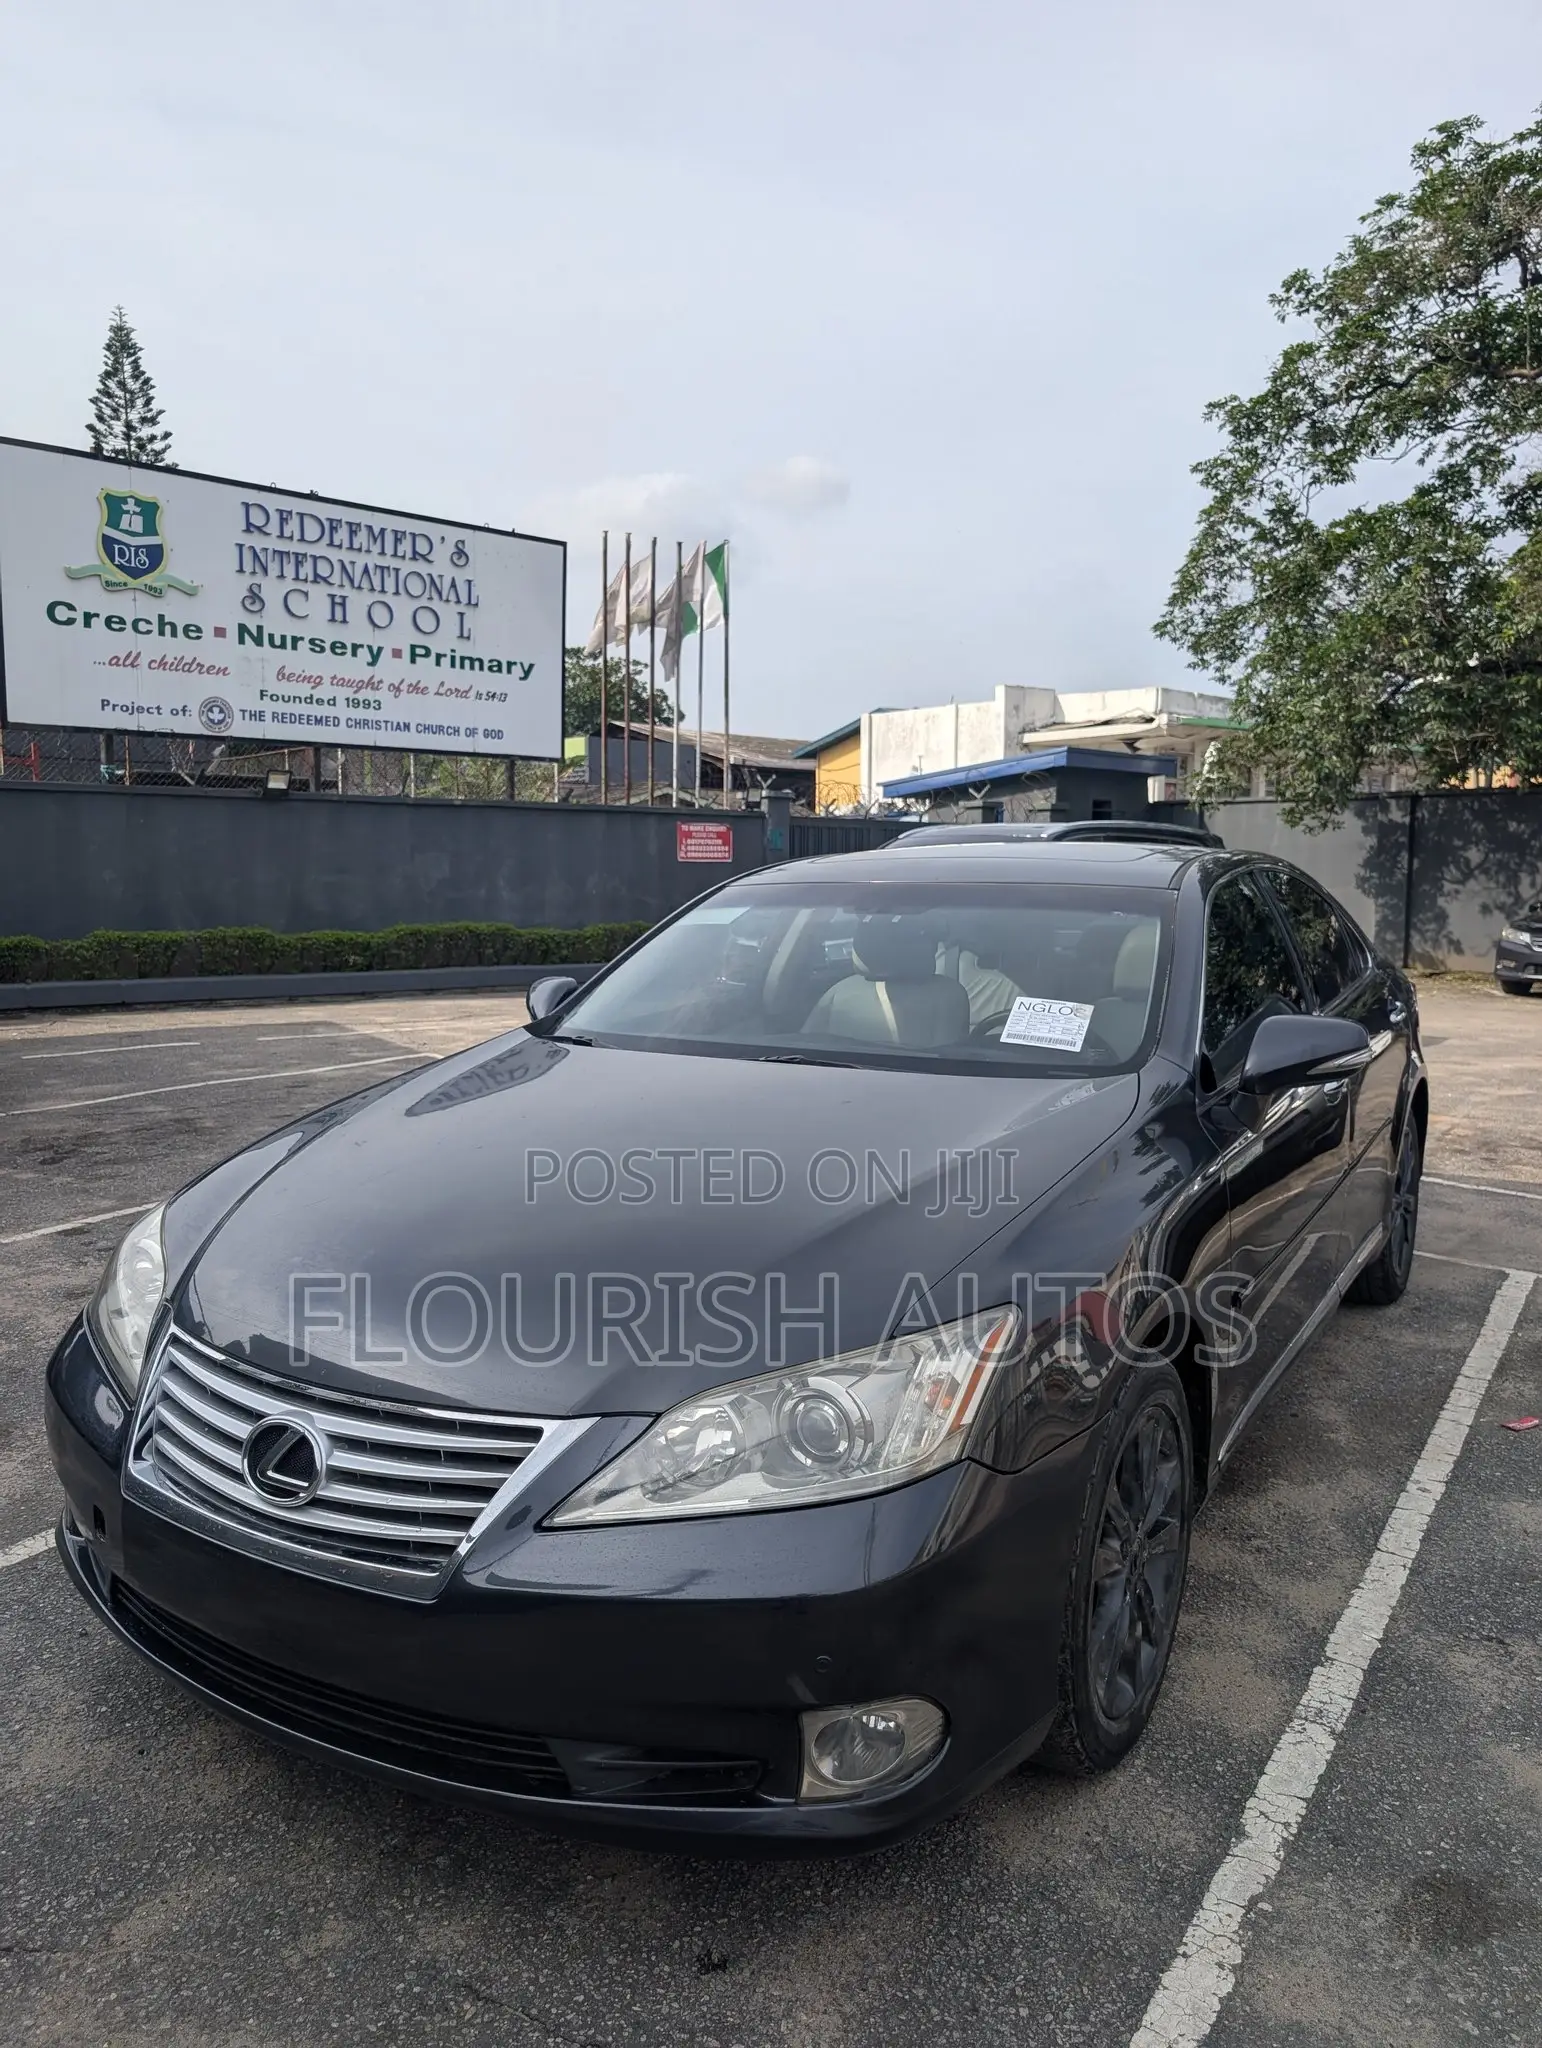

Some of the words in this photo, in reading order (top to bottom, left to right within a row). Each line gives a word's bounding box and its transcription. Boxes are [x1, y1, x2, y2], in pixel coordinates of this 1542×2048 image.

[112, 544, 150, 569] RIS
[241, 501, 470, 568] REDEEMER'S
[104, 580, 128, 588] Since
[143, 583, 163, 595] 1993
[234, 543, 479, 608] INTERNATIONAL
[46, 600, 204, 640] Creche
[237, 622, 385, 667] Nursery
[409, 643, 536, 681] Primary
[147, 653, 231, 677] children
[276, 665, 324, 690] being
[330, 672, 384, 695] taught
[388, 678, 404, 698] of
[406, 679, 430, 696] the
[434, 681, 472, 700] Lord
[100, 699, 163, 716] Project
[170, 704, 193, 718] of:
[239, 708, 266, 722] THE
[271, 711, 341, 728] REDEEMED
[346, 717, 411, 733] CHRISTIAN
[416, 723, 460, 737] CHURCH
[464, 727, 478, 738] OF
[483, 728, 504, 740] GOD
[259, 689, 337, 707] Founded
[344, 696, 383, 711] 1993
